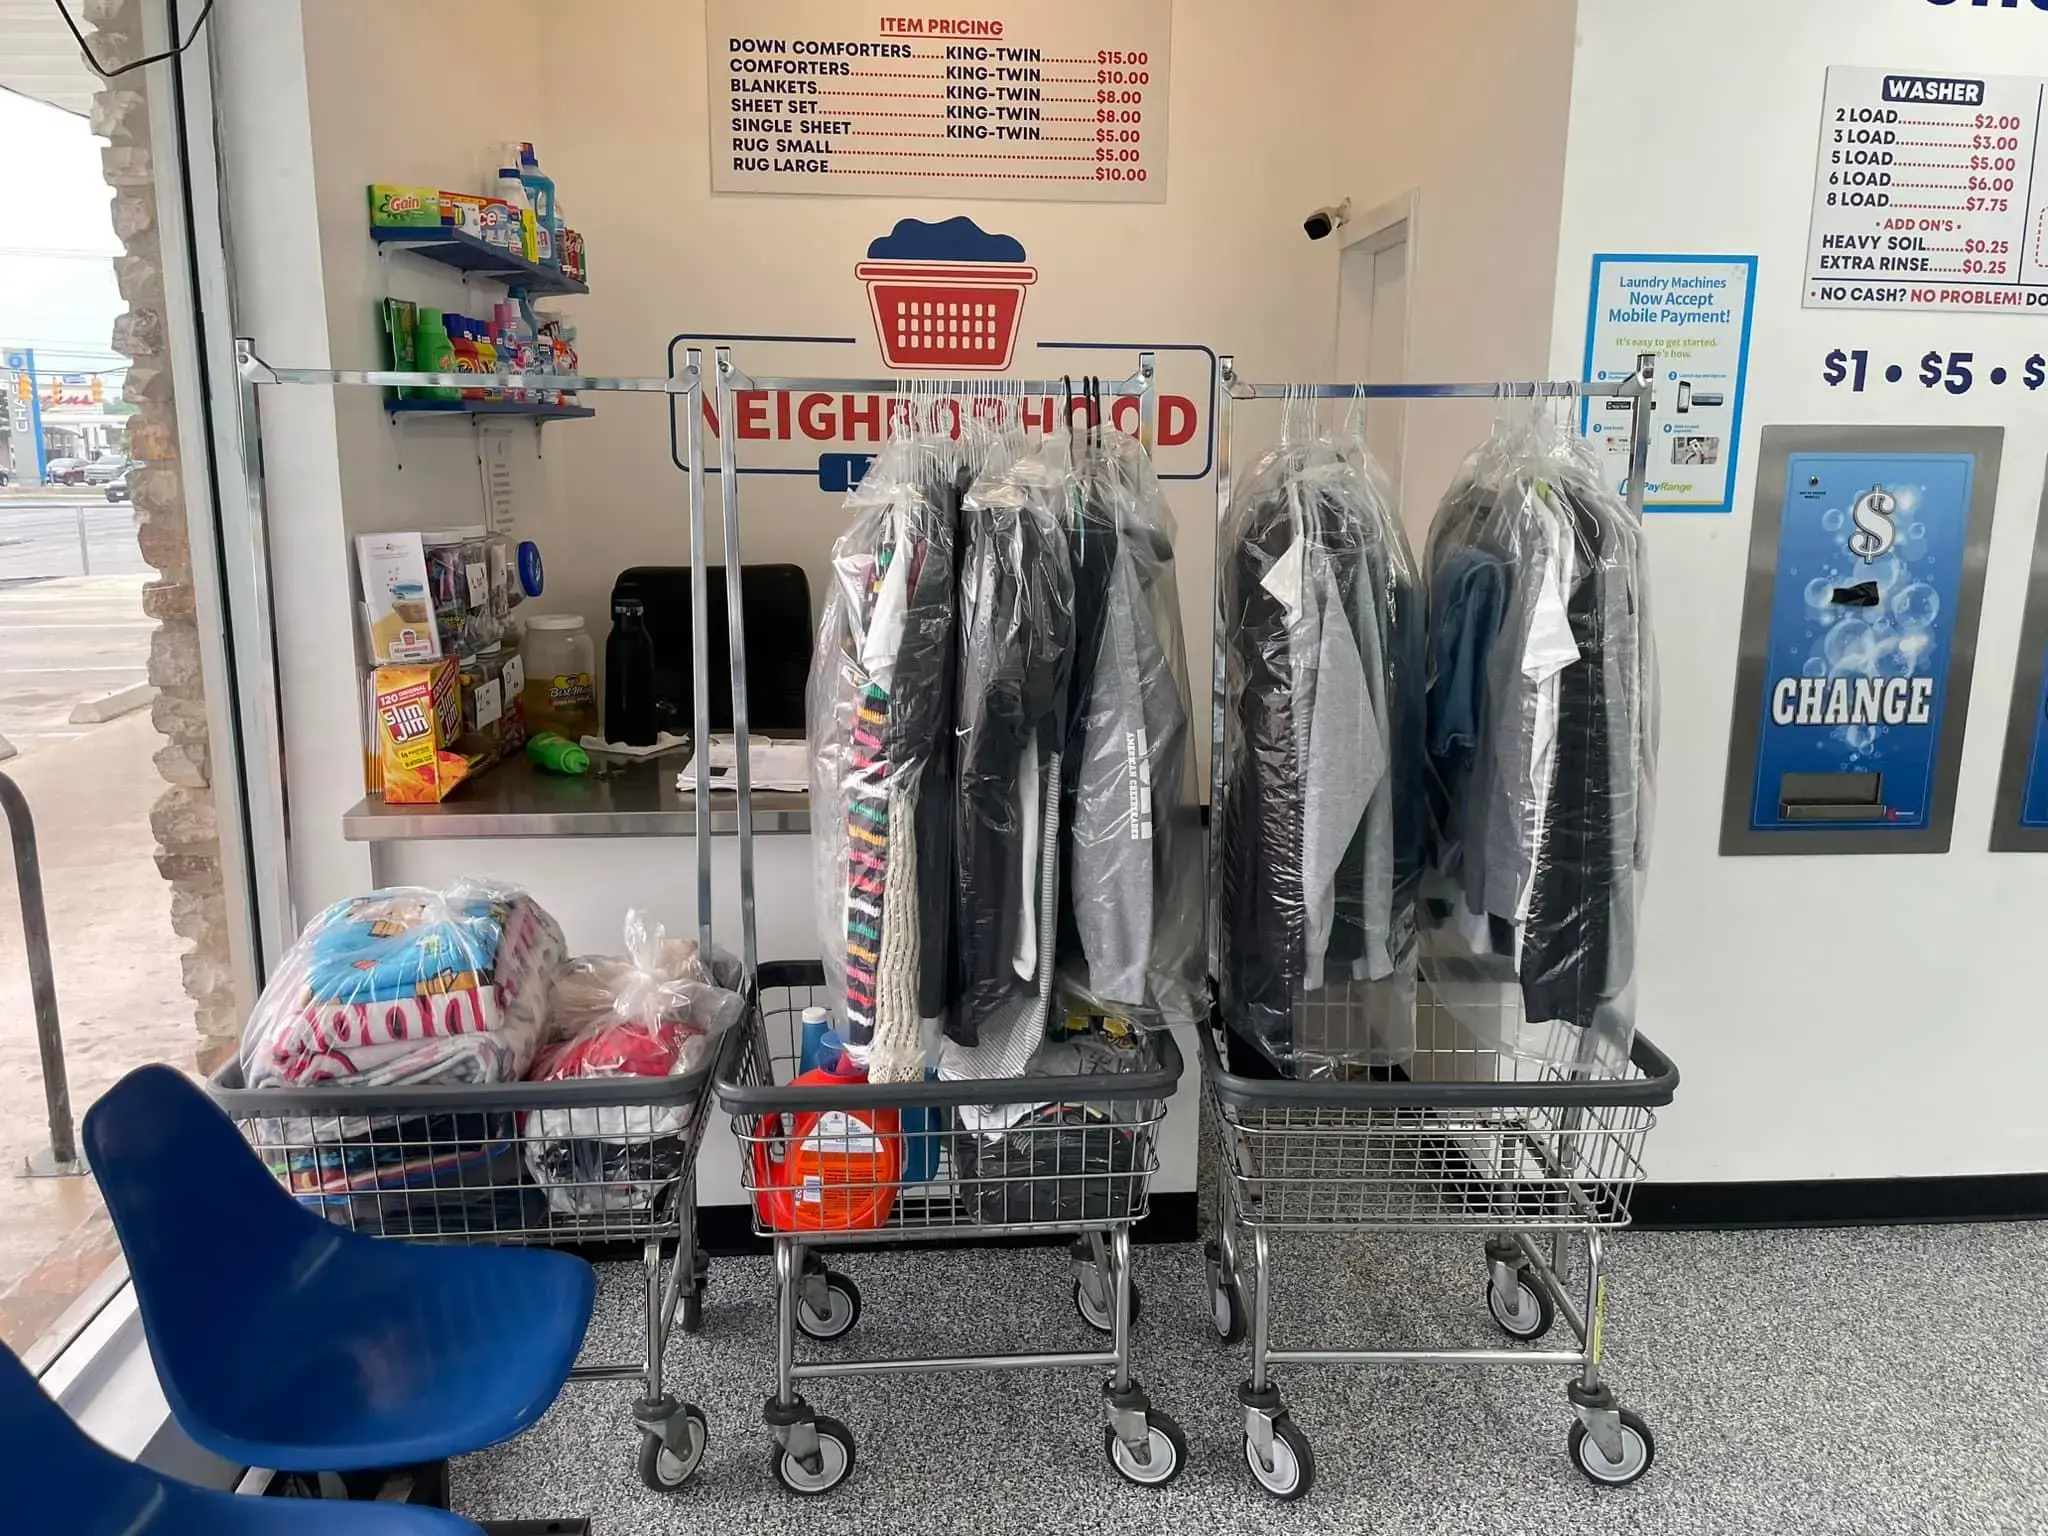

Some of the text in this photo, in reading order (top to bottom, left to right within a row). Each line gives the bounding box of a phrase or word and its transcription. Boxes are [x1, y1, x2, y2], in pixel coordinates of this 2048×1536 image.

[880, 17, 1003, 35] ITEM PRICING
[729, 38, 1149, 65] DOWN COMFORTERS KING-TWIN $15.00
[730, 58, 1149, 85] COMFORTERS KING-TWIN $10.00
[730, 78, 1142, 105] BLANKETS KING-TWIN $8.00
[1888, 79, 1979, 102] WASHER
[731, 98, 1142, 124] SHEET SET KING-TWIN $8.00
[1835, 107, 2021, 130] 2 LOAD $2.00
[731, 118, 1141, 143] SINGLE SHEET KING-TWIN $5.00
[1833, 129, 2018, 151] 3 LOAD $3.00
[732, 138, 1140, 162] RUG SMALL $5.00
[1831, 150, 2016, 171] 5 LOAD $5.00
[733, 157, 1147, 182] RUG LARGE $10.00
[1829, 172, 2014, 192] 6 LOAD $6.00
[390, 195, 420, 212] Gain
[1826, 192, 2008, 212] 8 LOAD $7.75
[1884, 218, 1954, 232] ADD ON'S
[1822, 234, 2009, 254] HEAVY SOIL $0.25
[1820, 255, 2006, 275] EXTRA RINSE $0.25
[1619, 276, 1727, 290] Laundry Machines
[1630, 291, 1715, 309] Now Accept
[1820, 287, 1846, 301] NO
[1850, 287, 1907, 302] CASH?
[1910, 288, 1936, 303] NO
[1940, 289, 2022, 306] PROBLEM!
[1609, 308, 1731, 326] Mobile Payment!
[1616, 337, 1718, 348] It's easy to get started.
[1823, 349, 1869, 393] $1
[1918, 351, 1974, 395] $5
[380, 693, 399, 706] 120
[1771, 677, 1933, 725] CHANGE
[1126, 731, 1137, 777] AMERICAN
